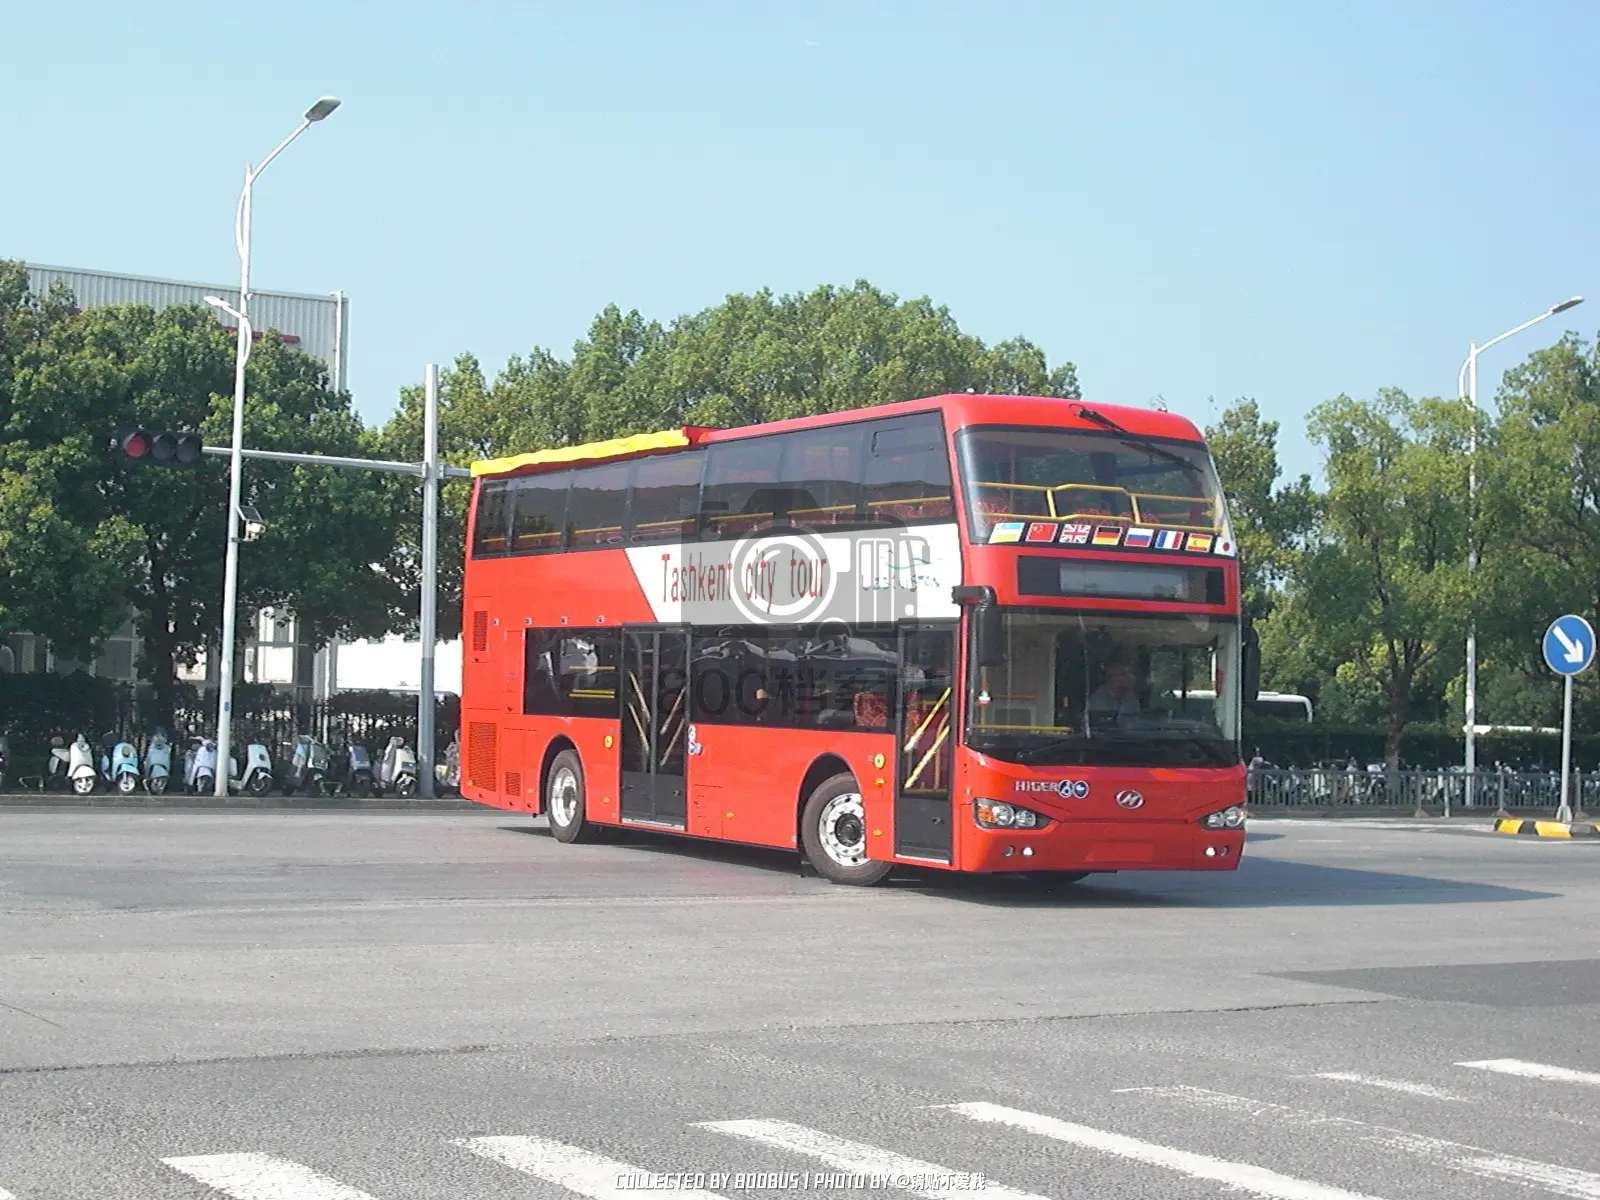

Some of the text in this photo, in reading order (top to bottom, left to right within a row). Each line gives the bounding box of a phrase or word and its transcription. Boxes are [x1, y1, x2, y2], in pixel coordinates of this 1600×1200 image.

[661, 548, 827, 615] Tashkent city tour
[1014, 780, 1058, 792] HIGER
